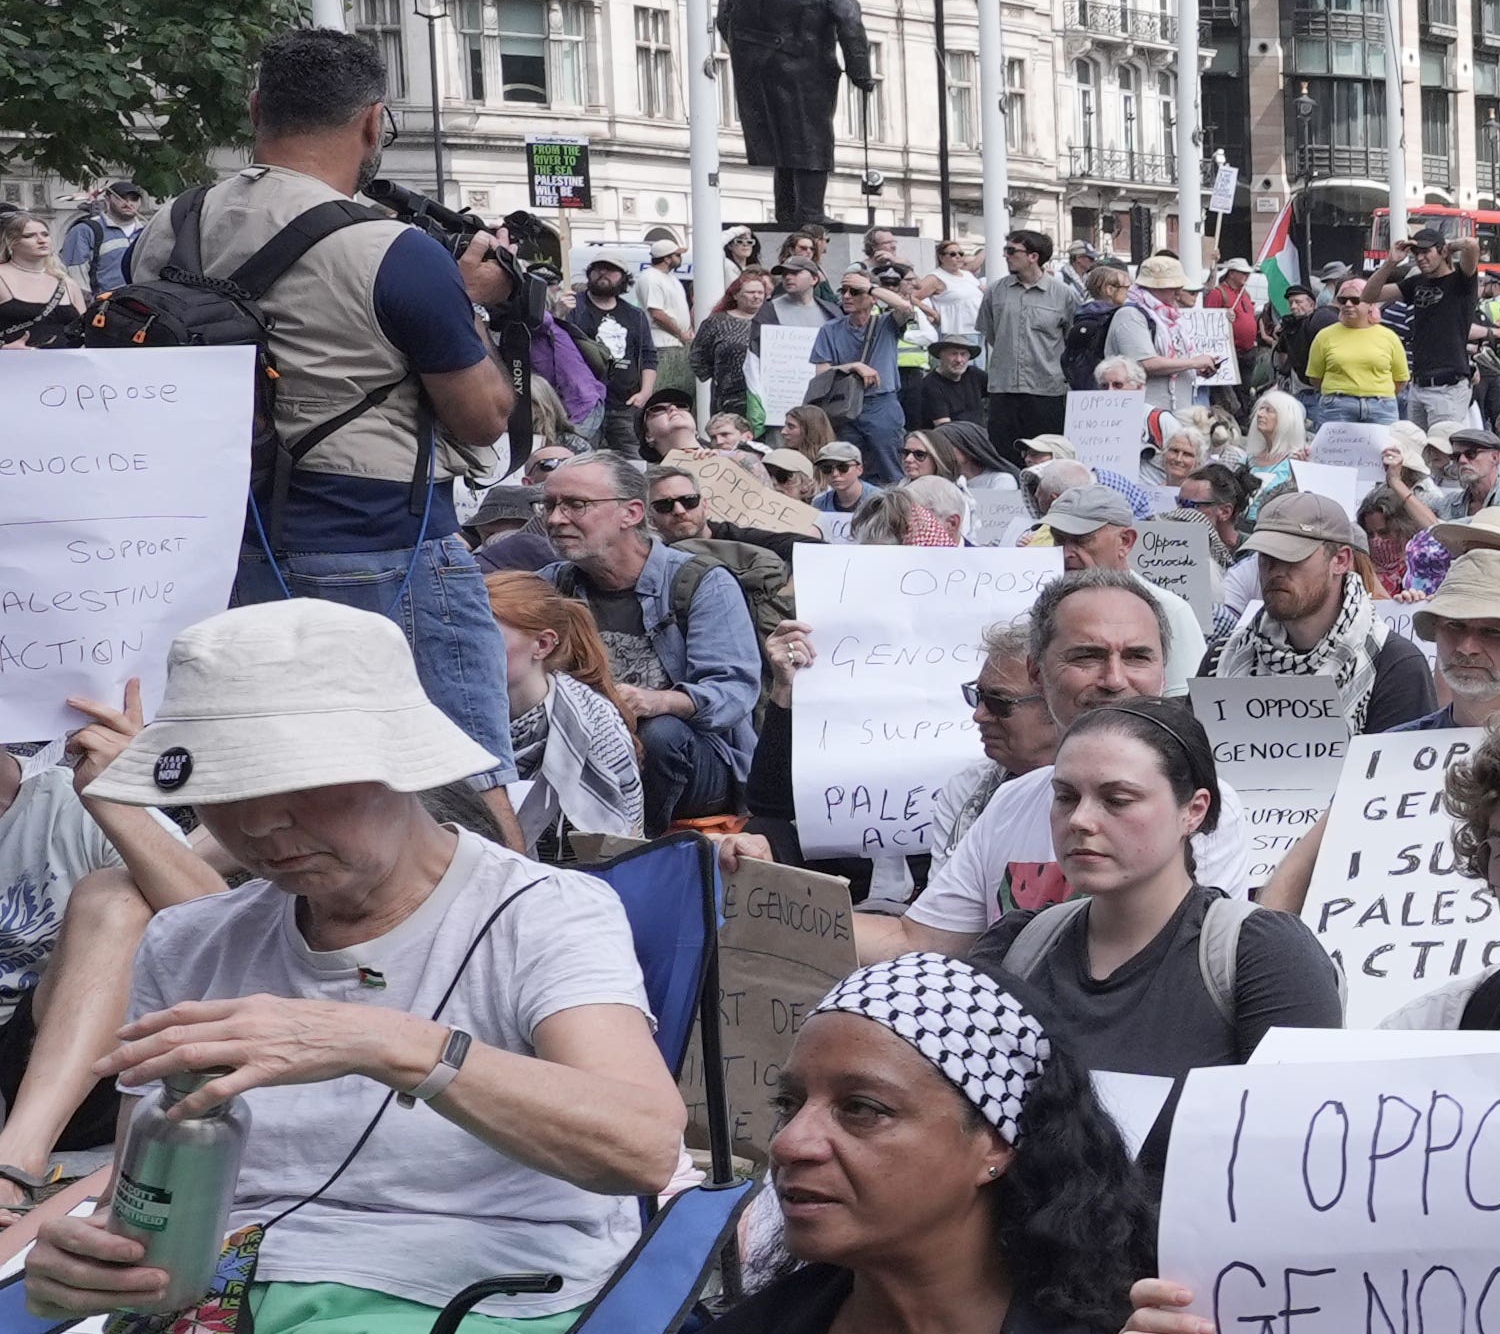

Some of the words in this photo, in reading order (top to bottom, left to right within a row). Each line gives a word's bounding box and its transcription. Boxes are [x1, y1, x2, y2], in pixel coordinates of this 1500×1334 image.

[533, 145, 560, 155] FROM
[563, 145, 581, 156] THE
[533, 155, 561, 165] RIVER
[565, 155, 577, 166] TO
[535, 166, 554, 175] THE
[555, 166, 573, 175] SEA
[534, 175, 585, 186] PALESTINE
[535, 186, 559, 196] WILL
[560, 186, 573, 197] BE
[535, 196, 559, 206] FREE
[512, 359, 523, 396] SONY
[699, 467, 797, 527] OPPOSE
[66, 537, 188, 565] SUPPORT
[1213, 699, 1227, 722] I
[1246, 698, 1341, 719] OPPOSE
[1213, 741, 1345, 763] GENOCIDE
[1366, 750, 1381, 779] I
[158, 770, 181, 782] NOW
[1228, 1088, 1249, 1223] I
